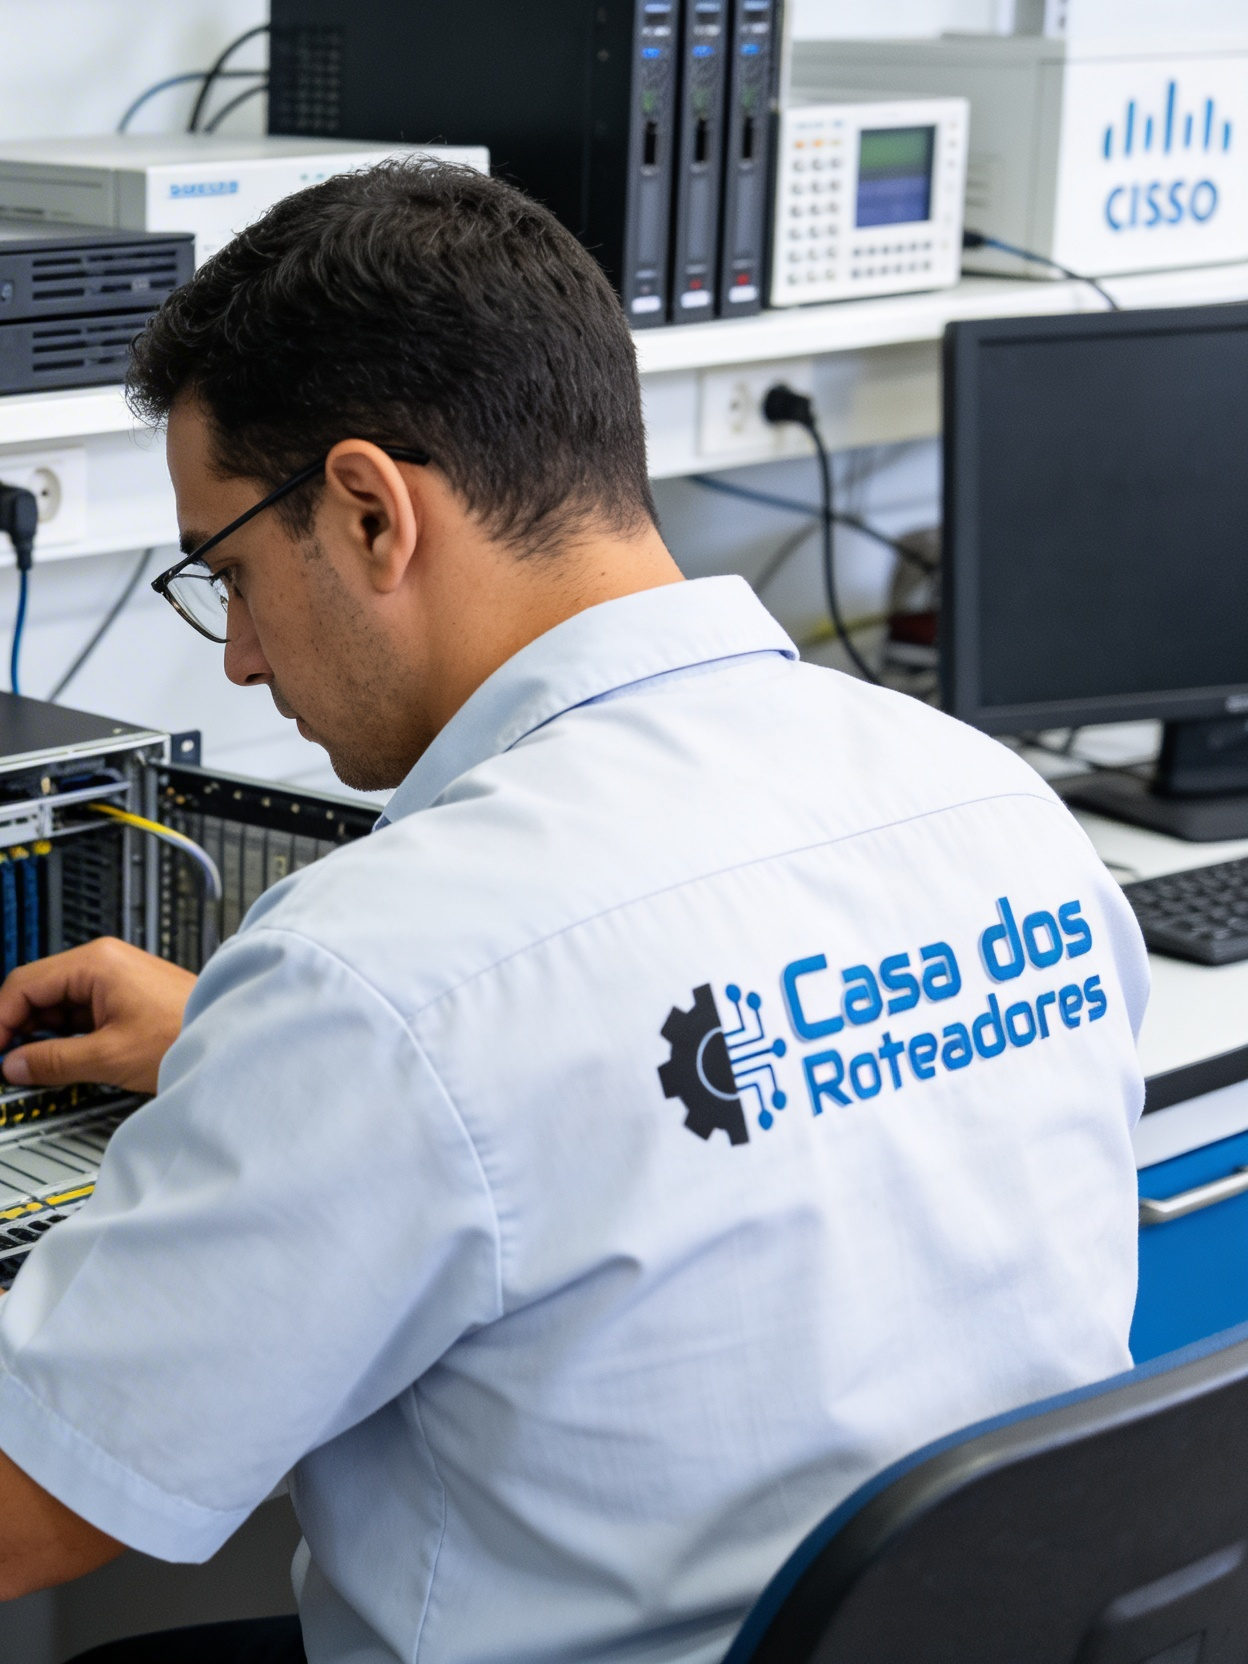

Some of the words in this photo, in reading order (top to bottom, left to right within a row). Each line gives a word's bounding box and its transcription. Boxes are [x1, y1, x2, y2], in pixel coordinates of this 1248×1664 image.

[1105, 178, 1218, 231] CISSO
[781, 941, 962, 1042] Casa
[979, 897, 1093, 984] dos
[801, 975, 1108, 1117] Roteadores
